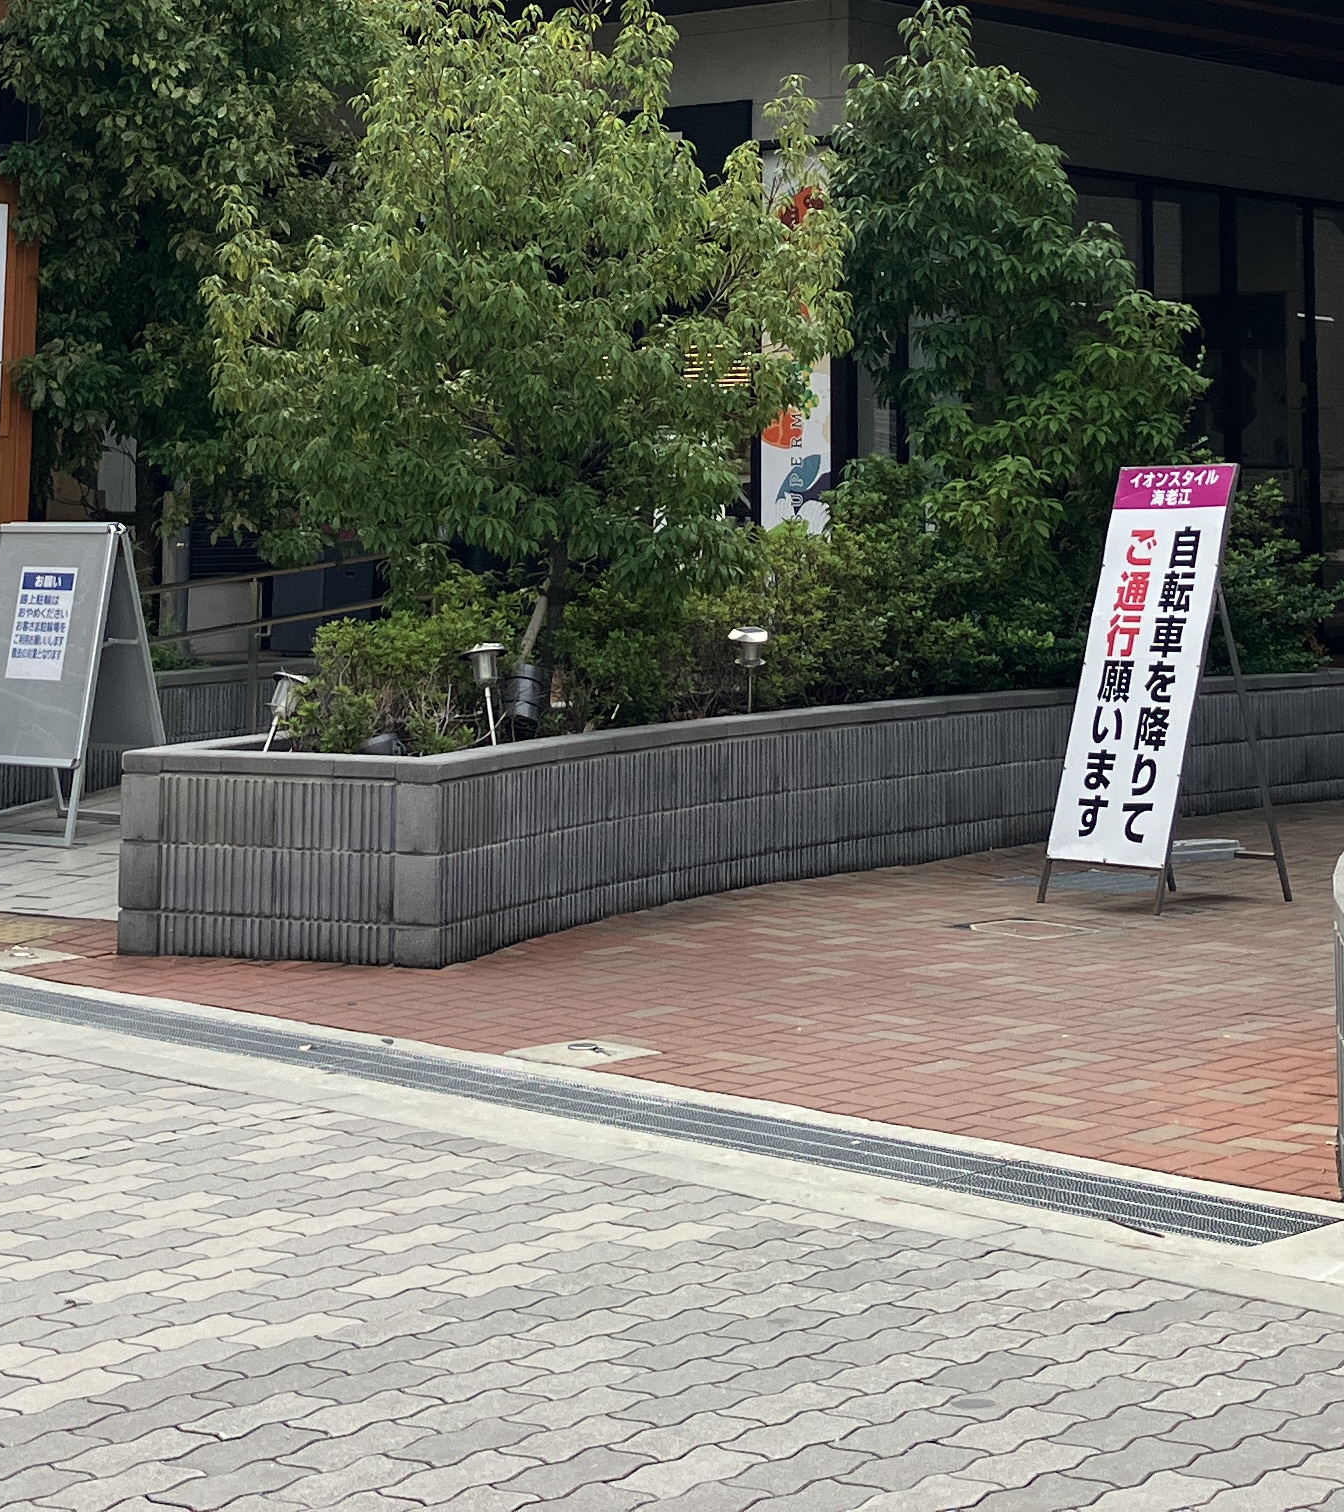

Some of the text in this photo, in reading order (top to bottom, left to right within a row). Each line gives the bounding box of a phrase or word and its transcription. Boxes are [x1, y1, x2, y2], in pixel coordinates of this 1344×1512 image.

[1130, 469, 1219, 488] イオンスタイル
[1150, 488, 1192, 506] 海老江
[1078, 529, 1158, 838] ご通行願います
[1122, 526, 1202, 844] 自転車を降りて
